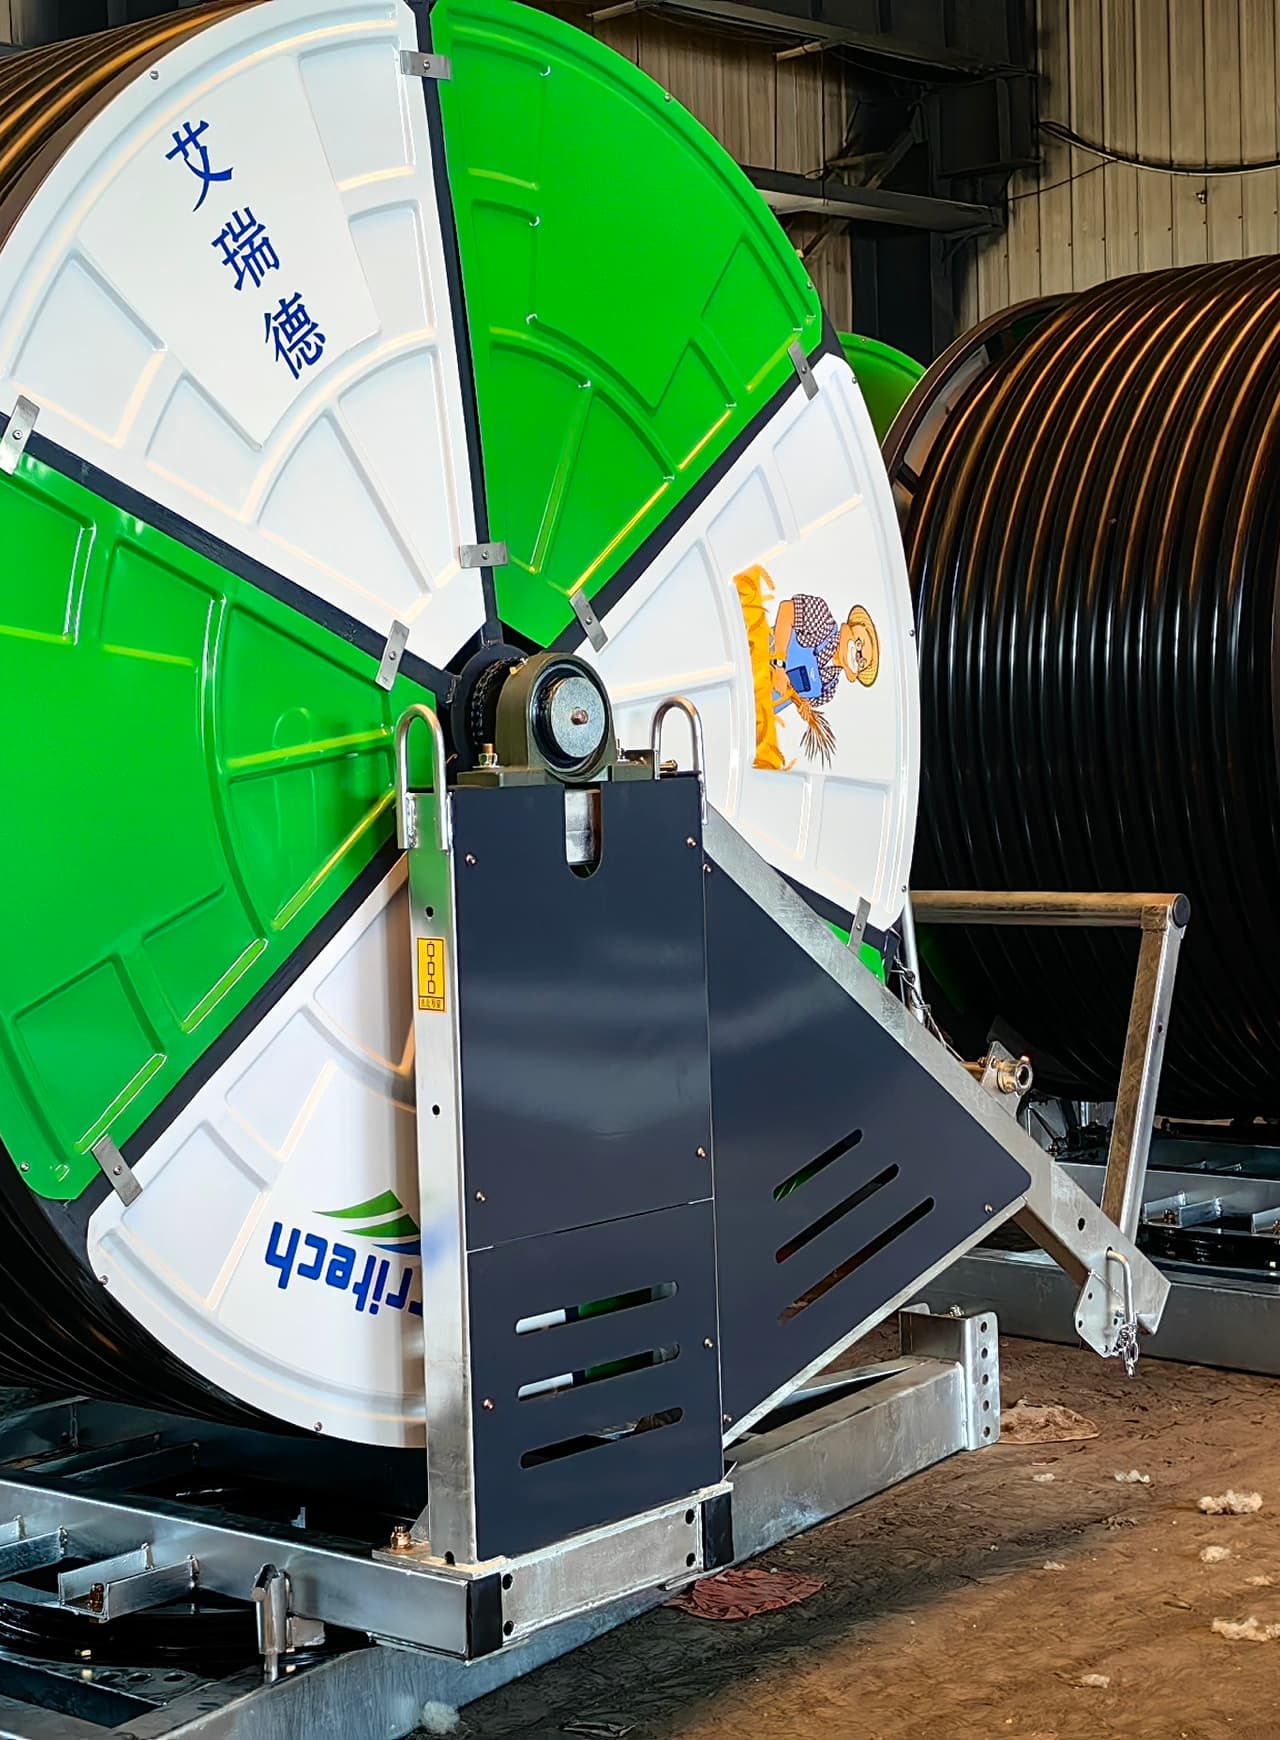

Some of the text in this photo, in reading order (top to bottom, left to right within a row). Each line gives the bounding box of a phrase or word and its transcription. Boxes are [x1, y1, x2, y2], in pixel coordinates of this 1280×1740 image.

[164, 119, 327, 381] 艾瑞德
[264, 1221, 423, 1317] ritech
